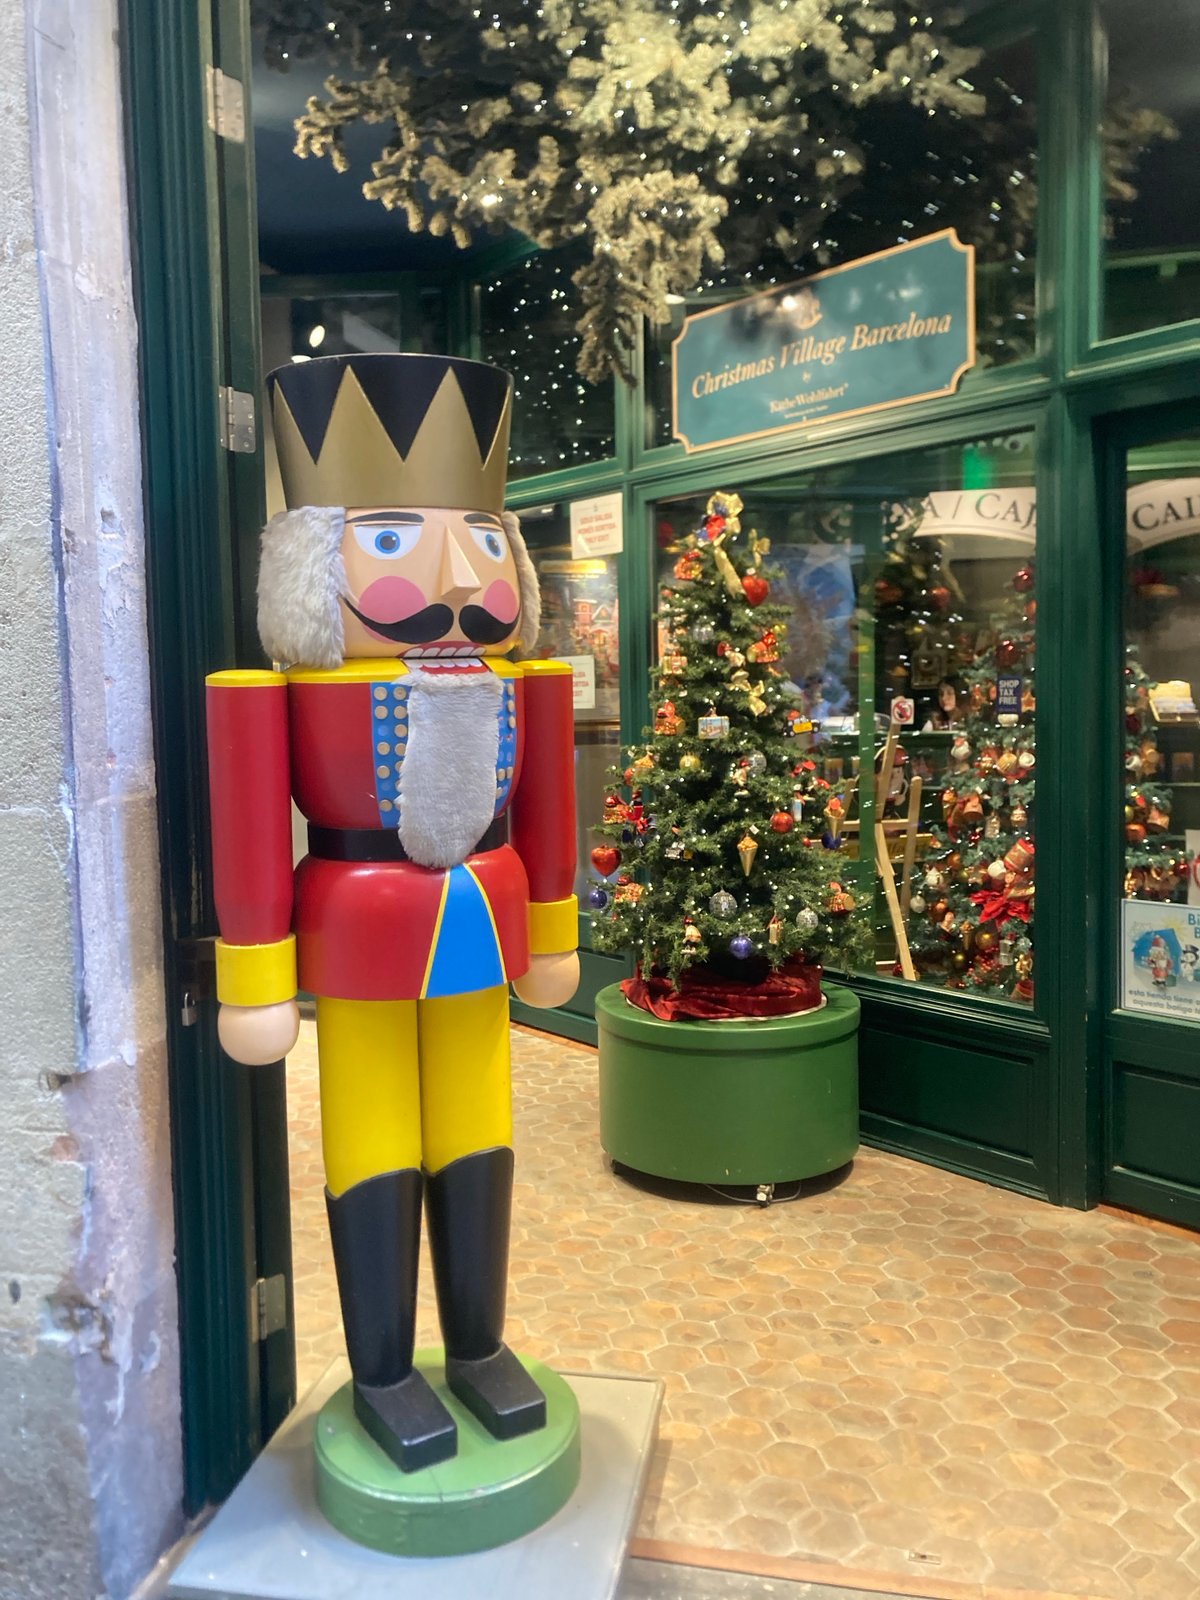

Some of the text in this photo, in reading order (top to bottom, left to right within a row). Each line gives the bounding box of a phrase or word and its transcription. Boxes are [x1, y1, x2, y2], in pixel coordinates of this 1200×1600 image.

[691, 311, 953, 399] Christmas Village Barcelona
[975, 492, 1035, 529] CAJ
[1132, 495, 1200, 531] CAI
[999, 679, 1020, 689] SHOP
[999, 688, 1014, 697] TAX
[999, 696, 1018, 705] FREE
